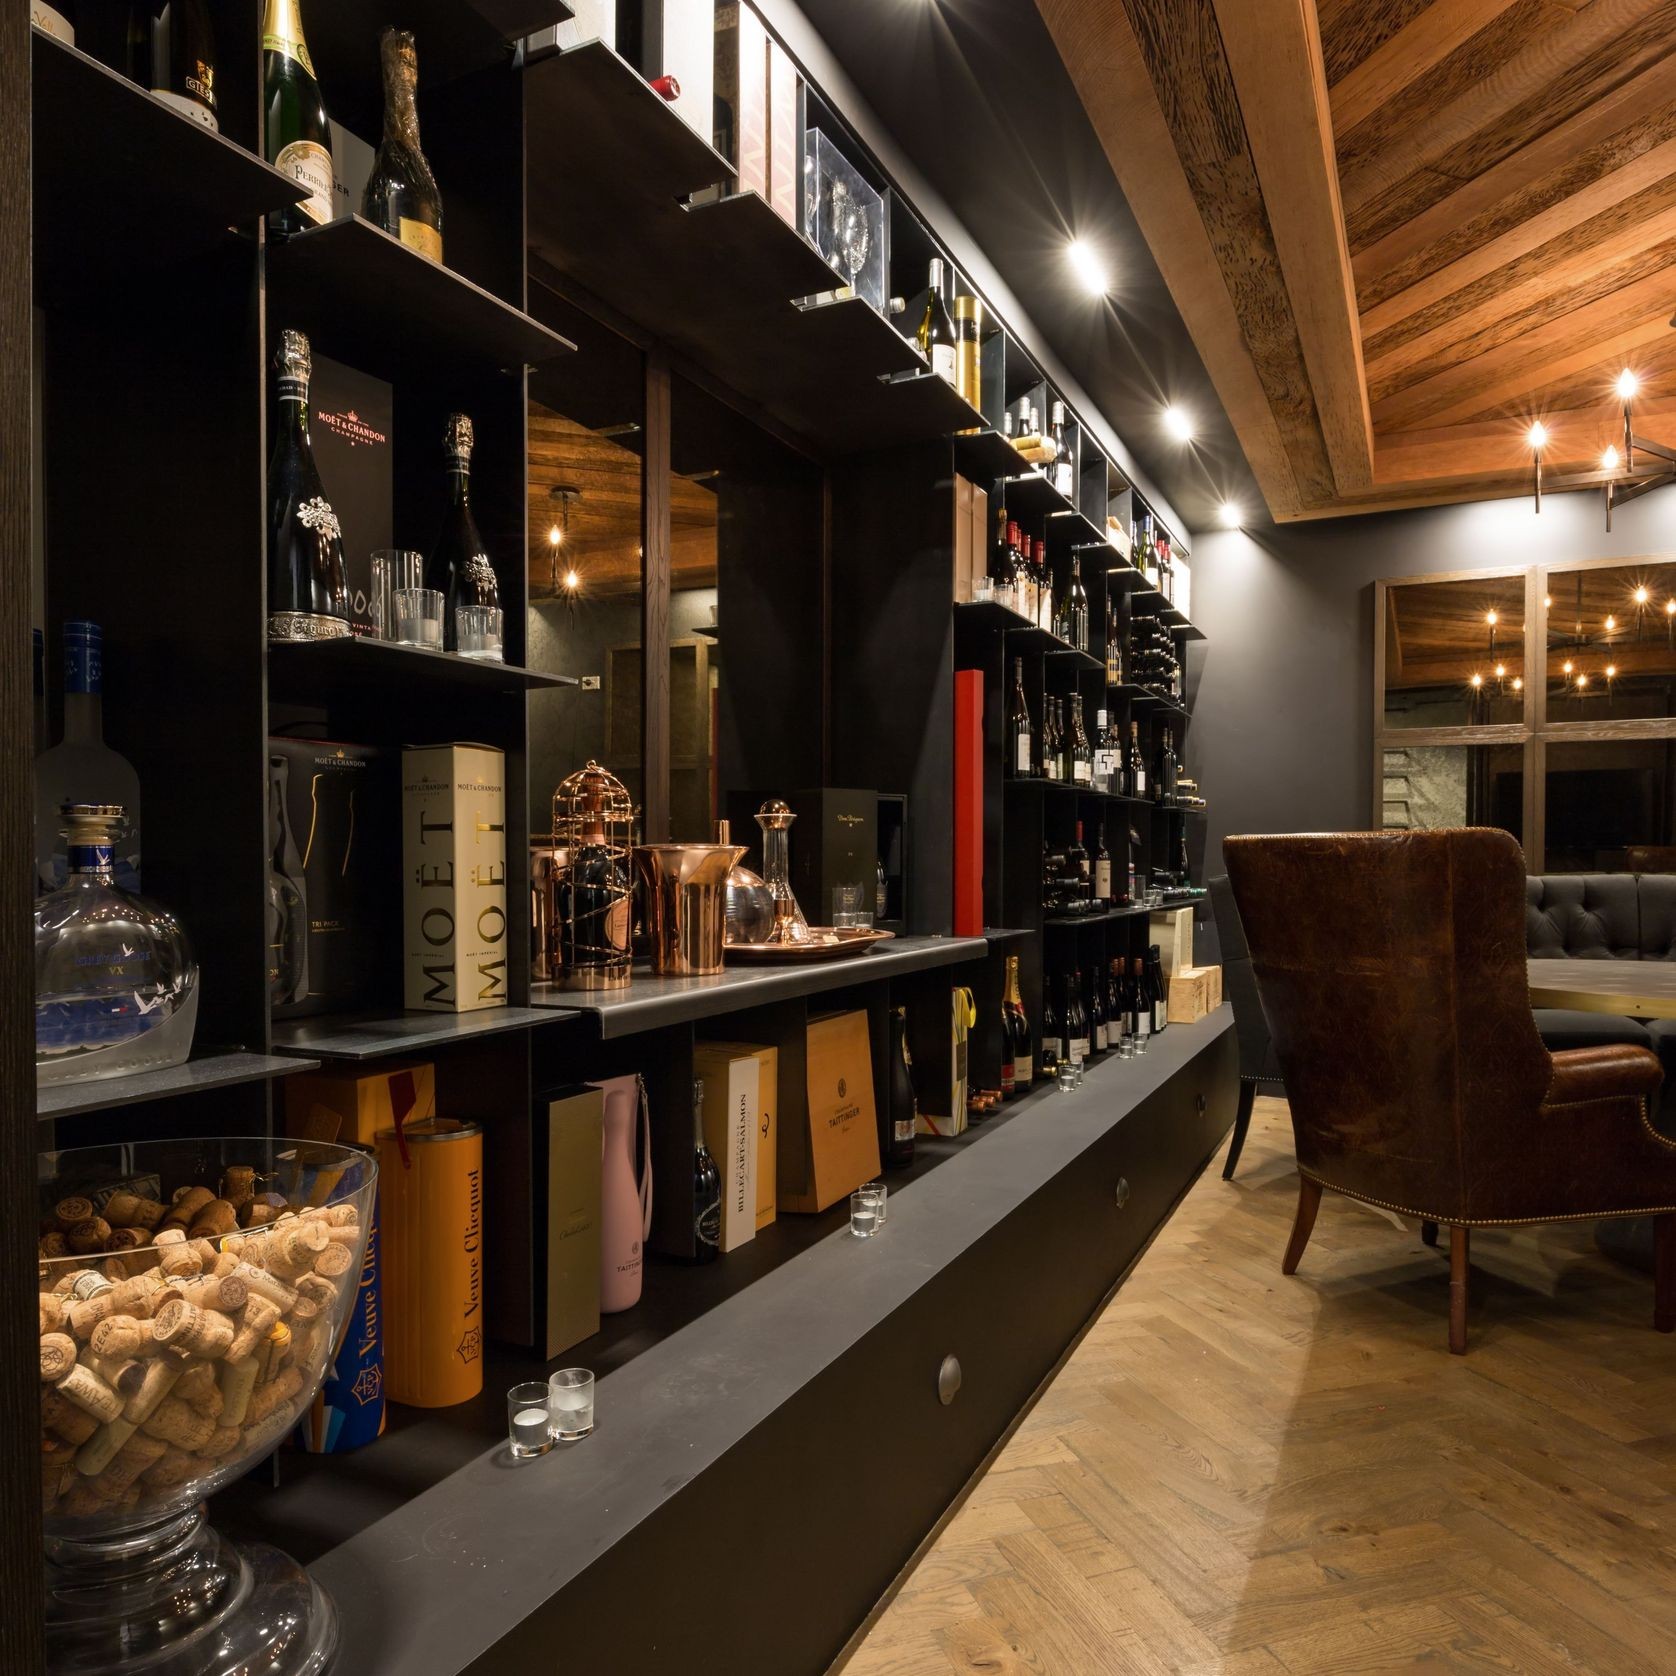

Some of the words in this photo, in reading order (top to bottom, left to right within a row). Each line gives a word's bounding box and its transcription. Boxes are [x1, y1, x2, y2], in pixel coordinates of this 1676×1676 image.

[330, 426, 373, 445] CHAMPAGNE
[347, 422, 386, 443] CHANDON
[415, 810, 456, 1009] MOËT
[471, 810, 507, 1002] MOËT
[109, 965, 124, 976] VX
[463, 1169, 481, 1254] Clicquot
[463, 1257, 480, 1319] Veuve
[359, 1290, 378, 1358] Veuve
